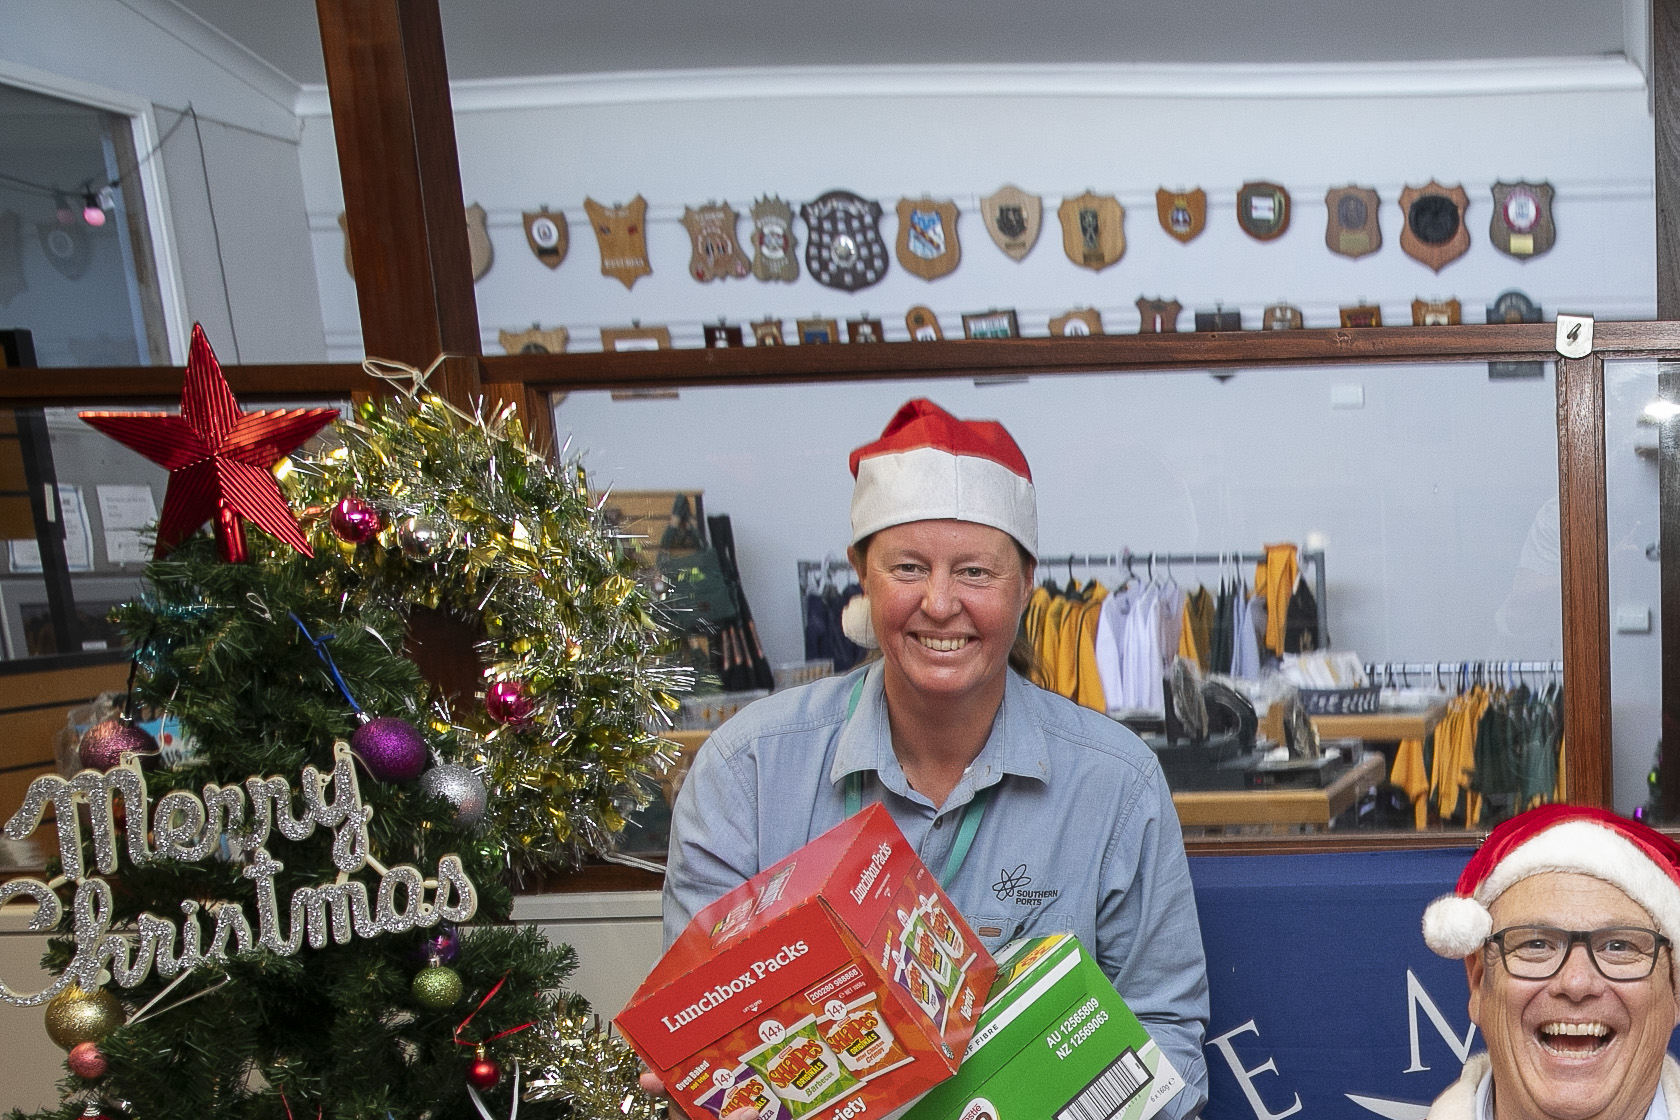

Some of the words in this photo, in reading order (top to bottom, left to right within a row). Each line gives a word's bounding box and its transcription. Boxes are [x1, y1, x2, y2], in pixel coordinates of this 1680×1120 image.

[3, 741, 373, 883] Merry
[1016, 889, 1058, 898] SOUTHERN
[661, 972, 757, 1033] Lunchbox
[750, 940, 809, 979] Packs
[959, 986, 976, 1022] Variety
[761, 1025, 783, 1042] 14x
[976, 1023, 999, 1047] FIBRE
[1046, 1034, 1062, 1049] AU
[1060, 998, 1100, 1036] 12565809
[1055, 1045, 1073, 1060] NZ
[1070, 1010, 1109, 1048] 12569063
[850, 1033, 878, 1056] ORIGINALS
[714, 1072, 733, 1086] 14x
[796, 1061, 825, 1088] ORIGINALS
[805, 1071, 835, 1098] Barbecue
